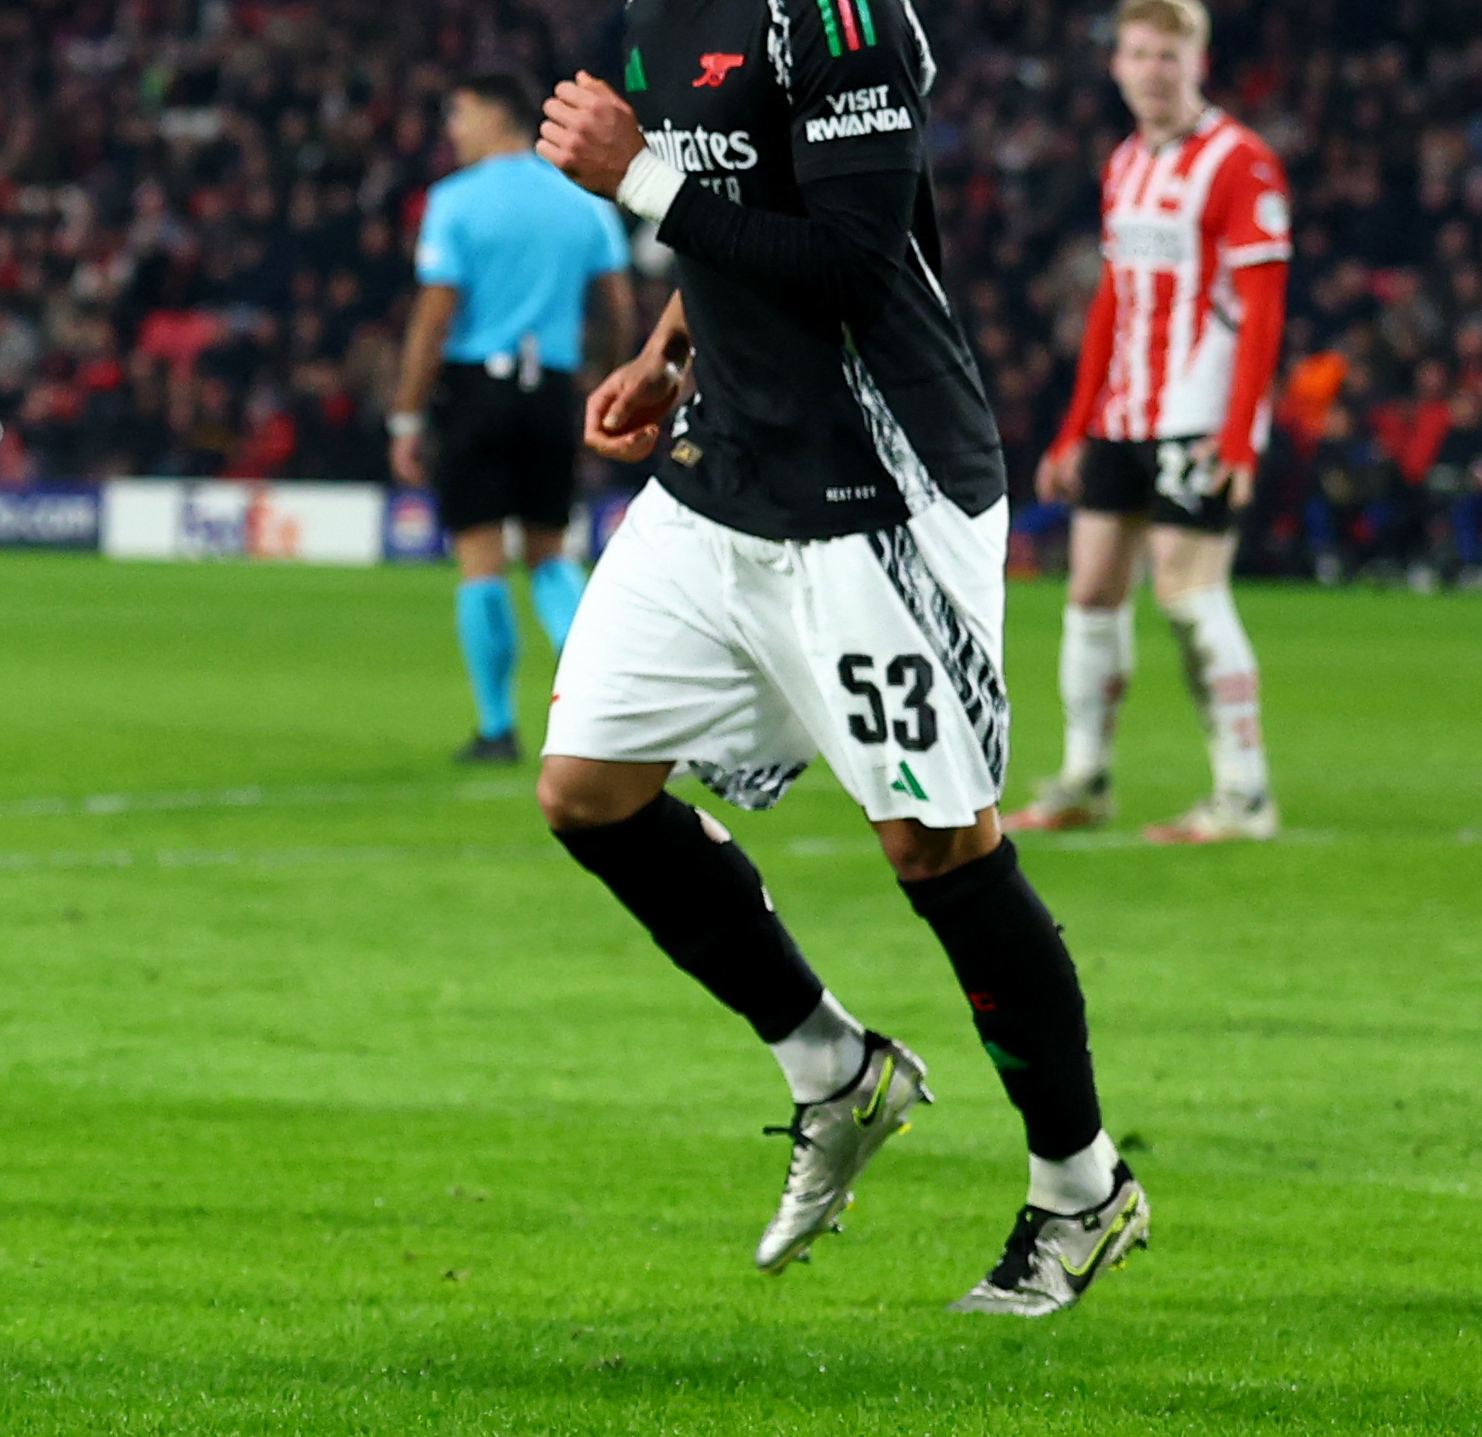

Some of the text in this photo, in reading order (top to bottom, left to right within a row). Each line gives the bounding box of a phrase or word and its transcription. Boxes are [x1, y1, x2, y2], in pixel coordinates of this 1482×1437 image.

[826, 85, 890, 114] VISIT
[638, 118, 758, 172] mirates
[805, 106, 913, 143] RWANDA
[837, 653, 938, 752] 53
